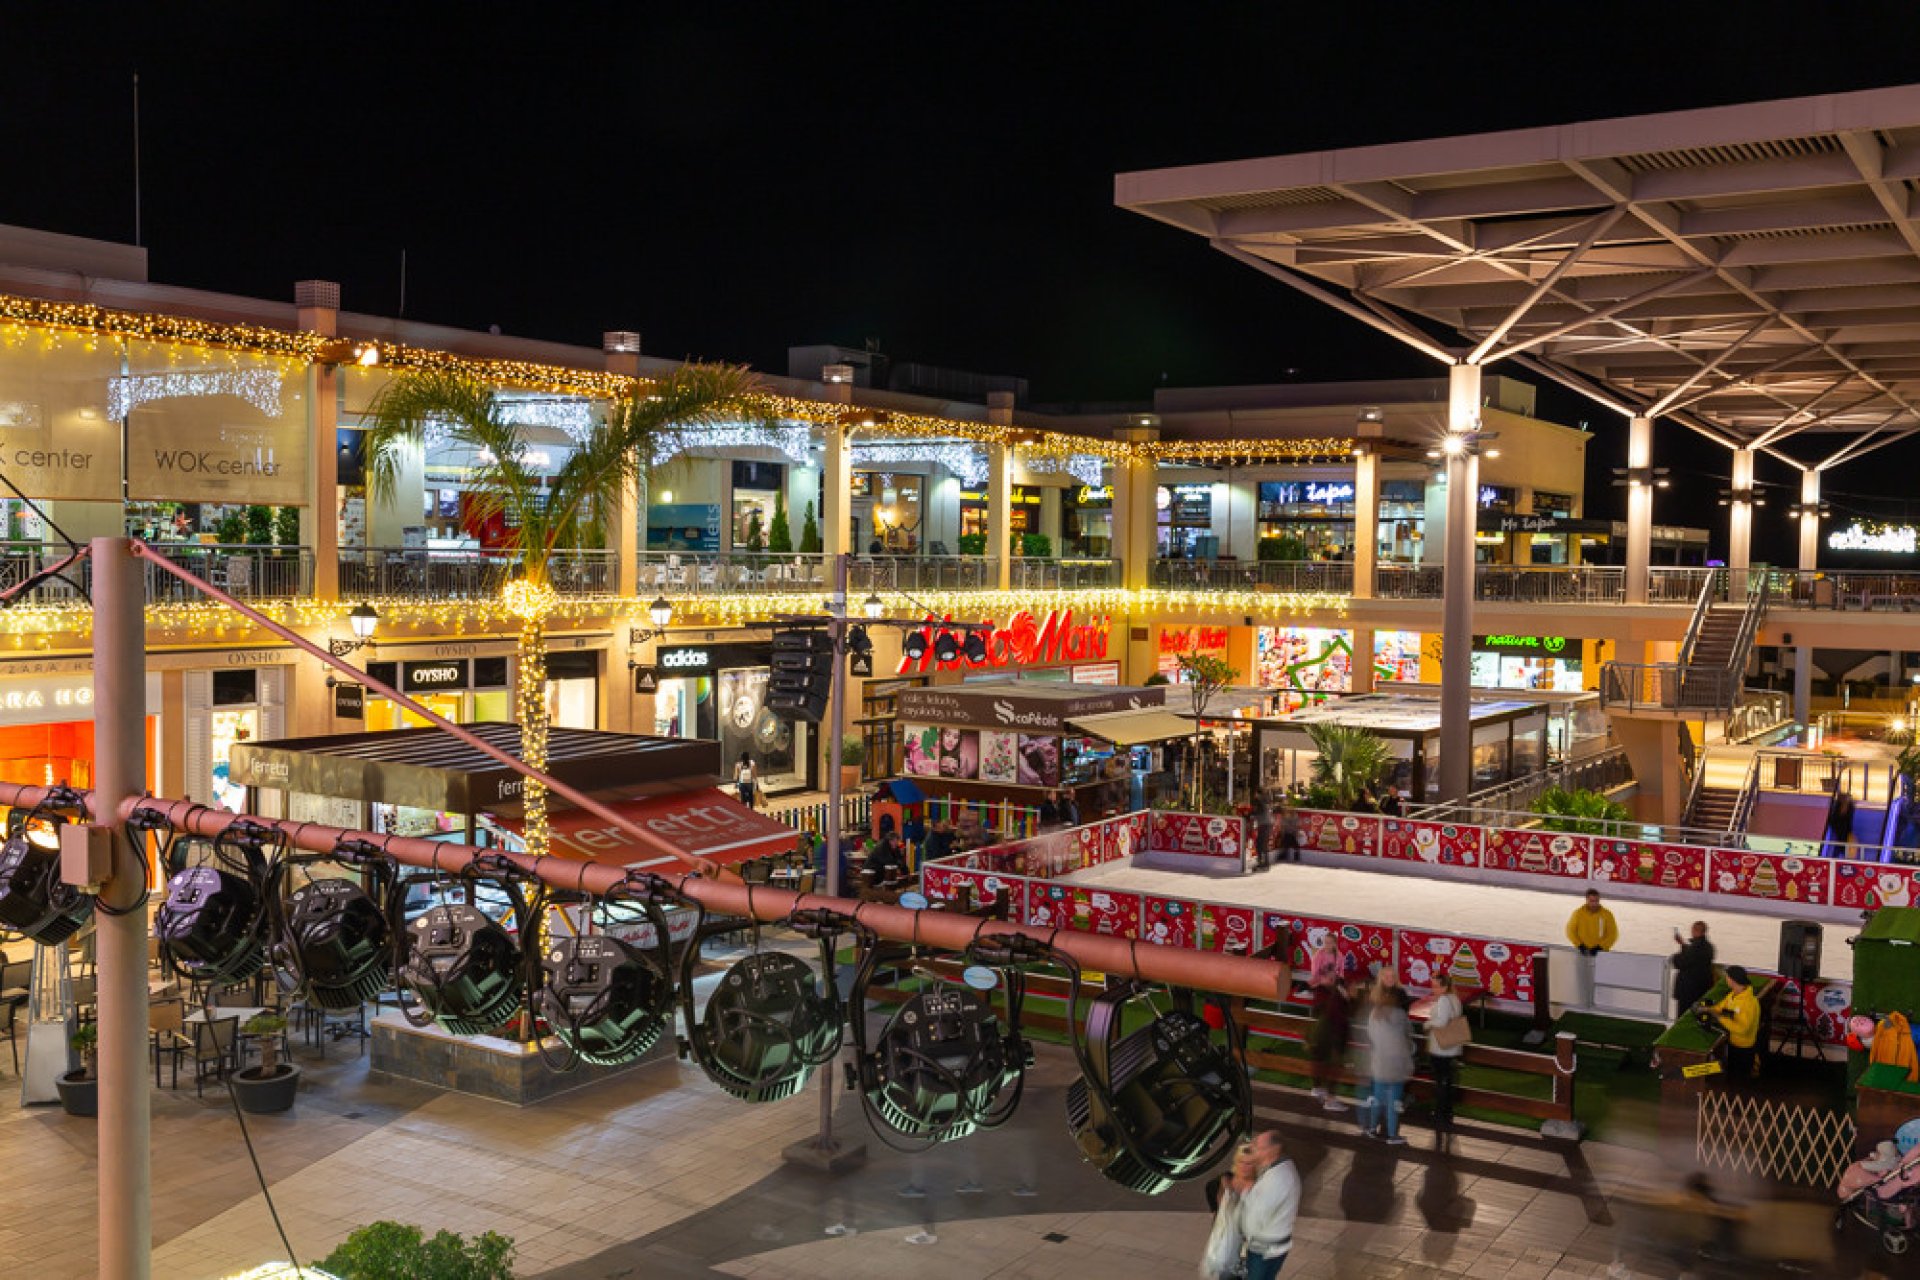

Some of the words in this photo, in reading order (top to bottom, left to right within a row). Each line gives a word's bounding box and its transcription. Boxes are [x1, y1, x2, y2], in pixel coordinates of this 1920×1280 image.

[14, 448, 93, 470] center
[154, 449, 211, 473] WOK
[216, 455, 282, 477] center
[1032, 609, 1111, 664] Markt
[227, 651, 281, 665] OYSHO
[434, 644, 477, 657] OYSHO
[662, 648, 709, 667] adidas
[8, 663, 58, 675] ZARA
[412, 667, 459, 684] OYSHO
[0, 689, 45, 709] RA
[543, 805, 746, 857] feretti
